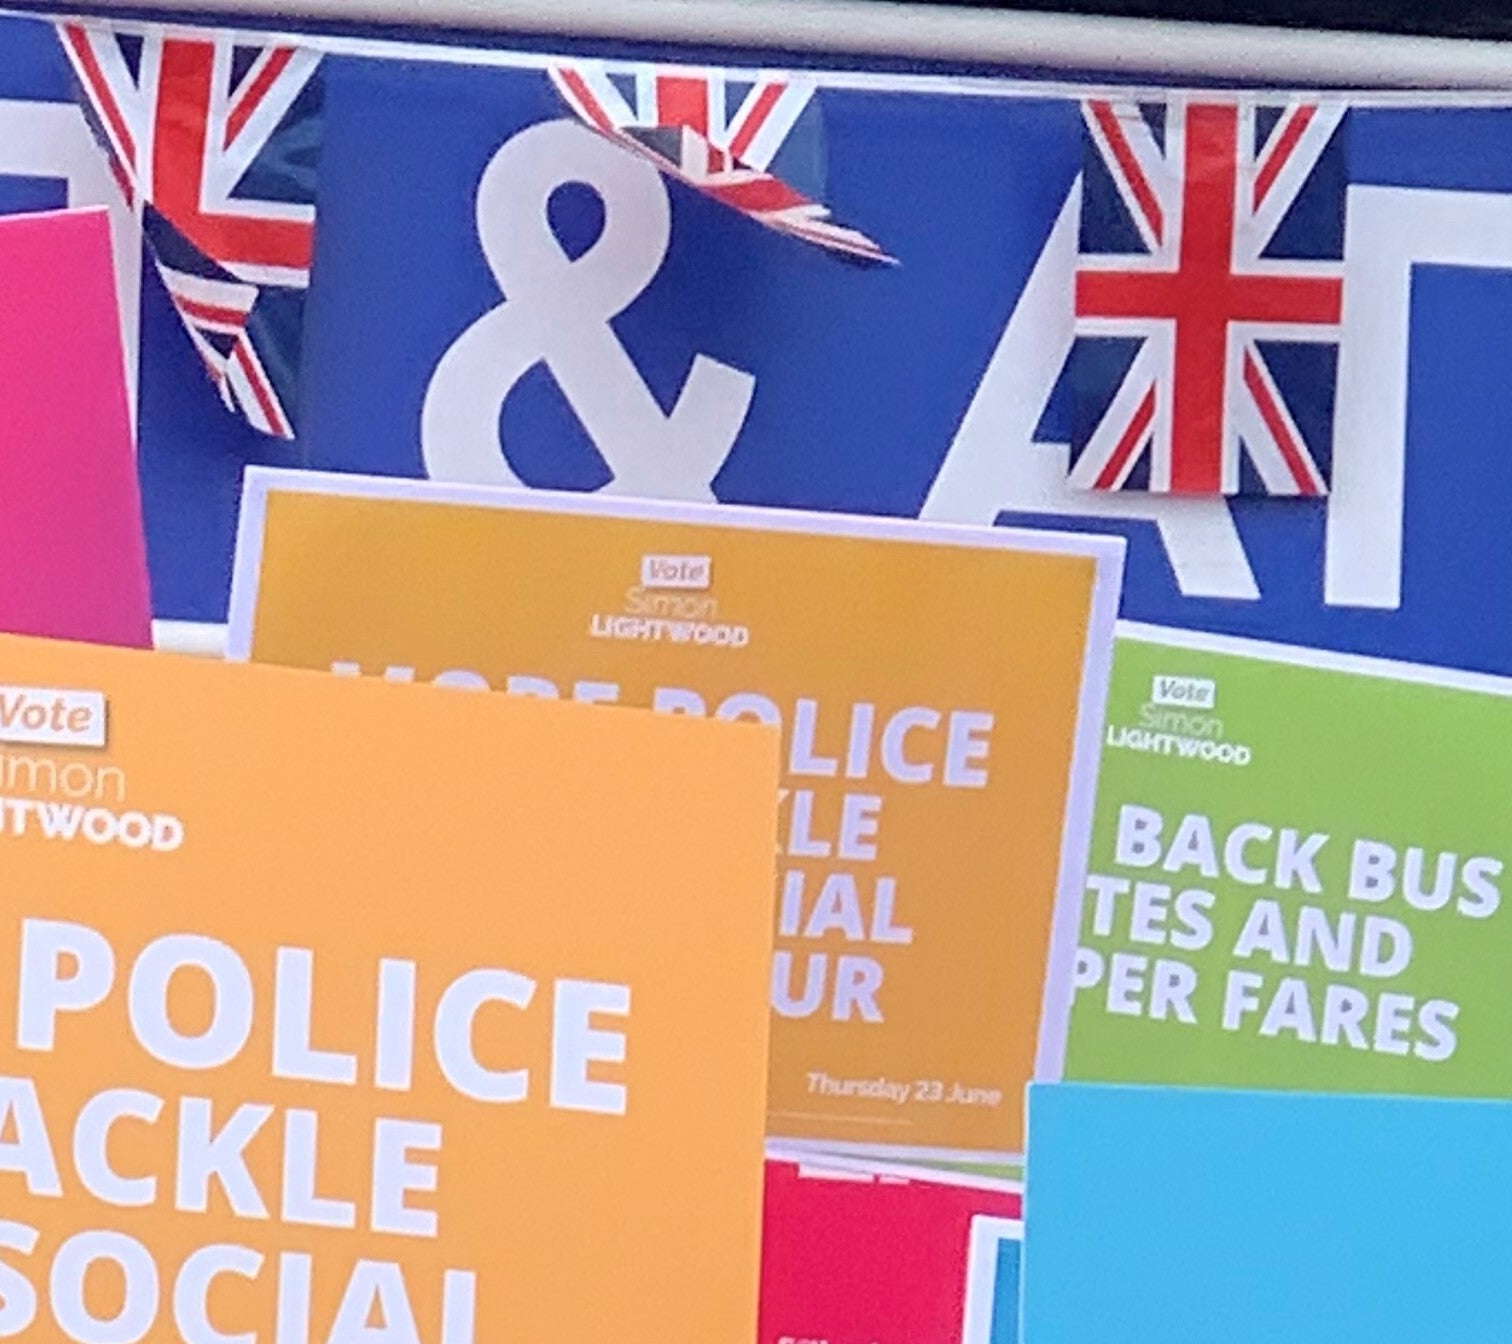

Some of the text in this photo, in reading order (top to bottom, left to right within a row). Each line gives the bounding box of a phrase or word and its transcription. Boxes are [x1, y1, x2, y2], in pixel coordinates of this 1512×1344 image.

[648, 558, 706, 581] Vote
[589, 613, 750, 648] LIGHTWOOD
[1158, 679, 1212, 702] Vote
[1139, 702, 1225, 740] Simon
[1105, 724, 1252, 766] LIGHTWOOD
[776, 788, 883, 862] LE
[1115, 803, 1504, 919] BACK BUS
[1086, 873, 1414, 979] TES AND
[16, 916, 632, 1116] POLICE
[1222, 969, 1461, 1062] FARES
[807, 1071, 1003, 1107] Thursday 23 June
